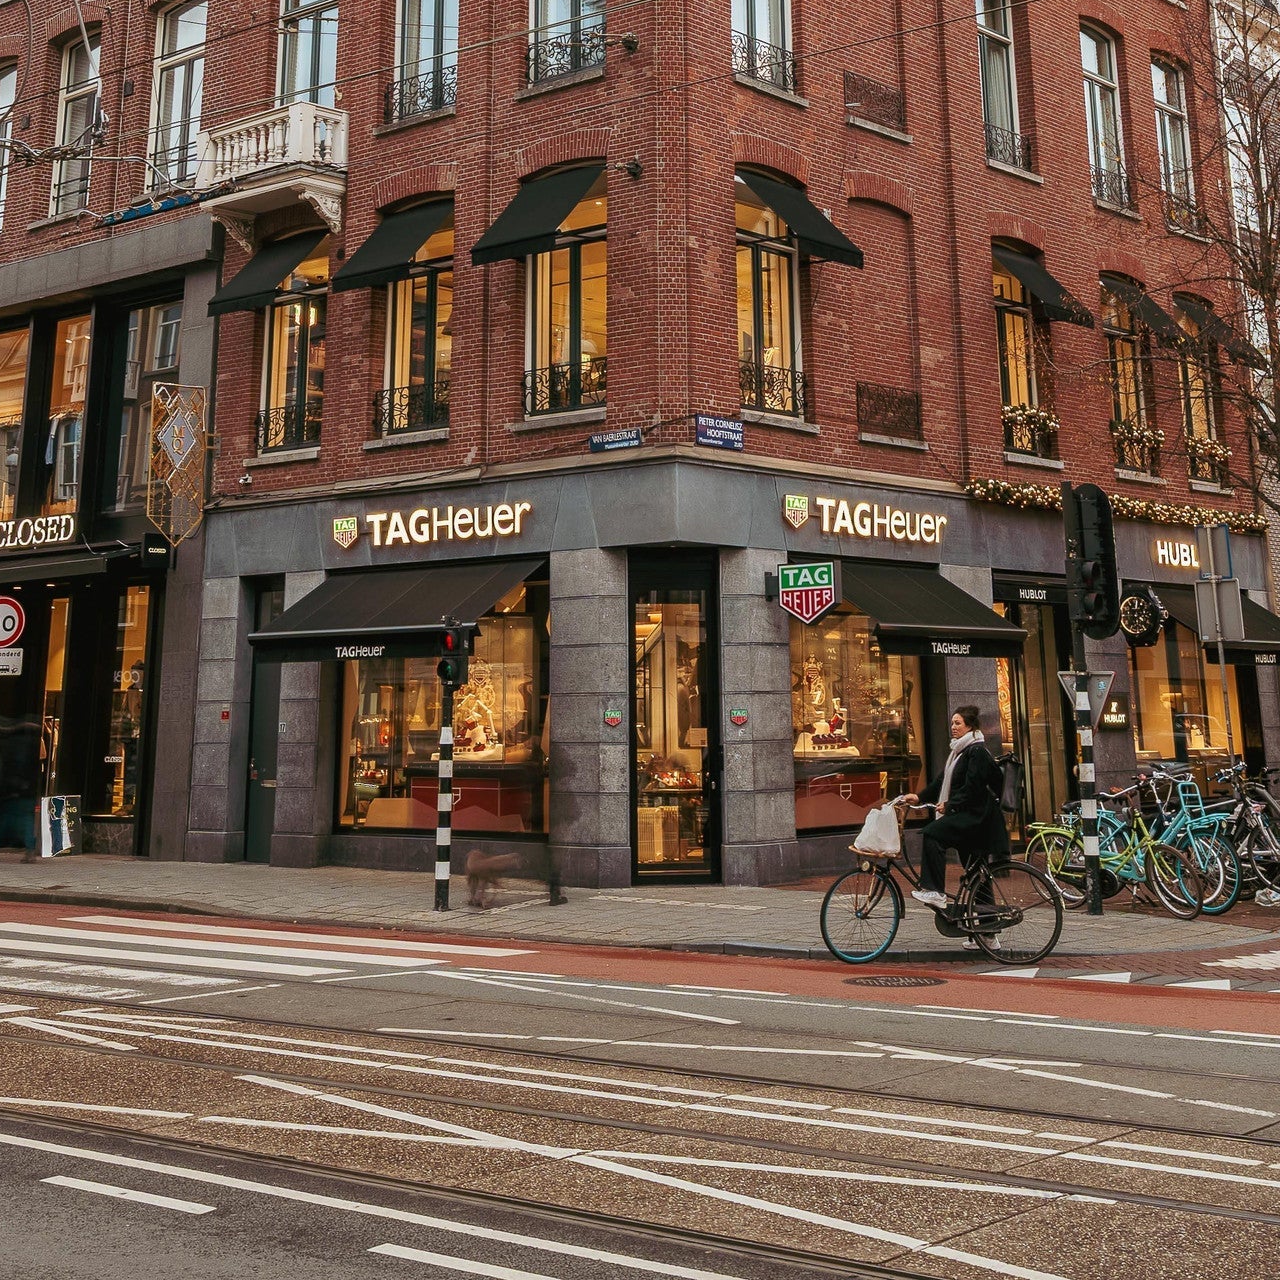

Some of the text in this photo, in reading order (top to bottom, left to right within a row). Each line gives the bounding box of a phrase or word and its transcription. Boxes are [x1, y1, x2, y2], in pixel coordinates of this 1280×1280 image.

[698, 416, 715, 427] PIETER
[591, 435, 603, 444] VAN
[707, 429, 743, 441] HOOFTSTRAAT
[787, 497, 807, 509] TAG
[335, 520, 356, 530] TAG
[1156, 540, 1199, 567] HUBL
[783, 567, 829, 586] TAG
[1019, 588, 1047, 600] HUBLOT
[783, 589, 832, 618] HEUER
[1255, 654, 1277, 664] HUBLOT
[1104, 713, 1126, 724] HUBLOT
